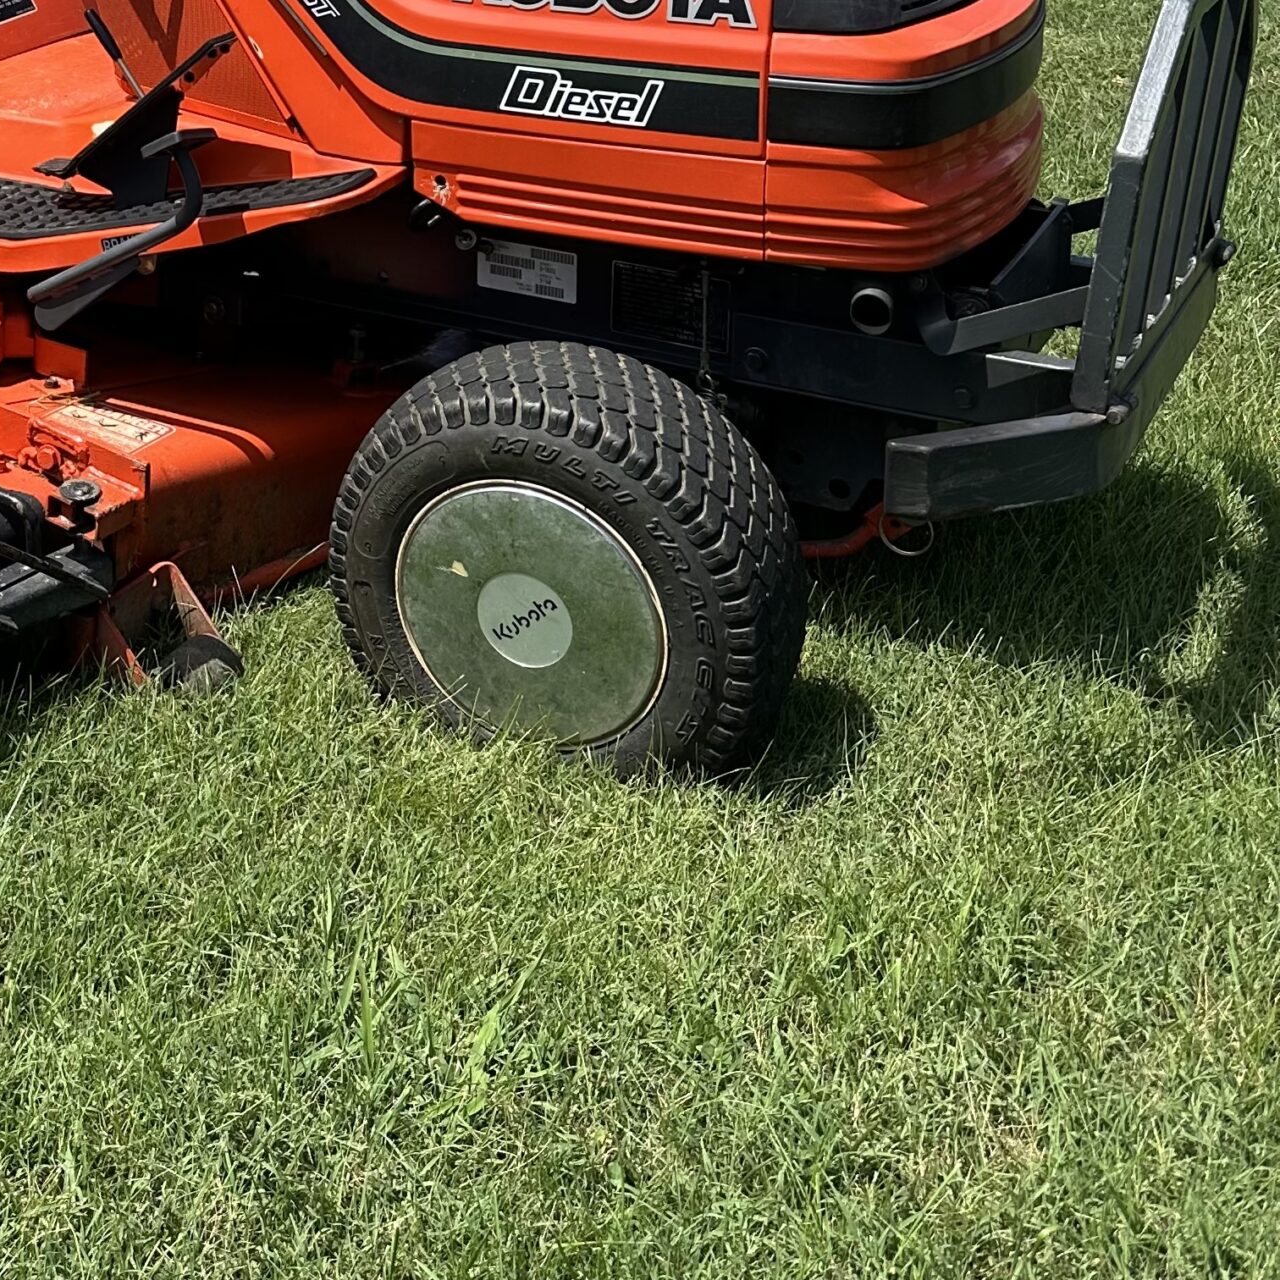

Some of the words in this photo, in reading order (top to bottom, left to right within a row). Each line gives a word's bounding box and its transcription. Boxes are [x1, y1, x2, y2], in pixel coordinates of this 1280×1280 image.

[499, 65, 664, 126] Diesel
[491, 434, 638, 507] MULTI
[645, 517, 714, 647] TRAC
[492, 596, 559, 641] Kubota
